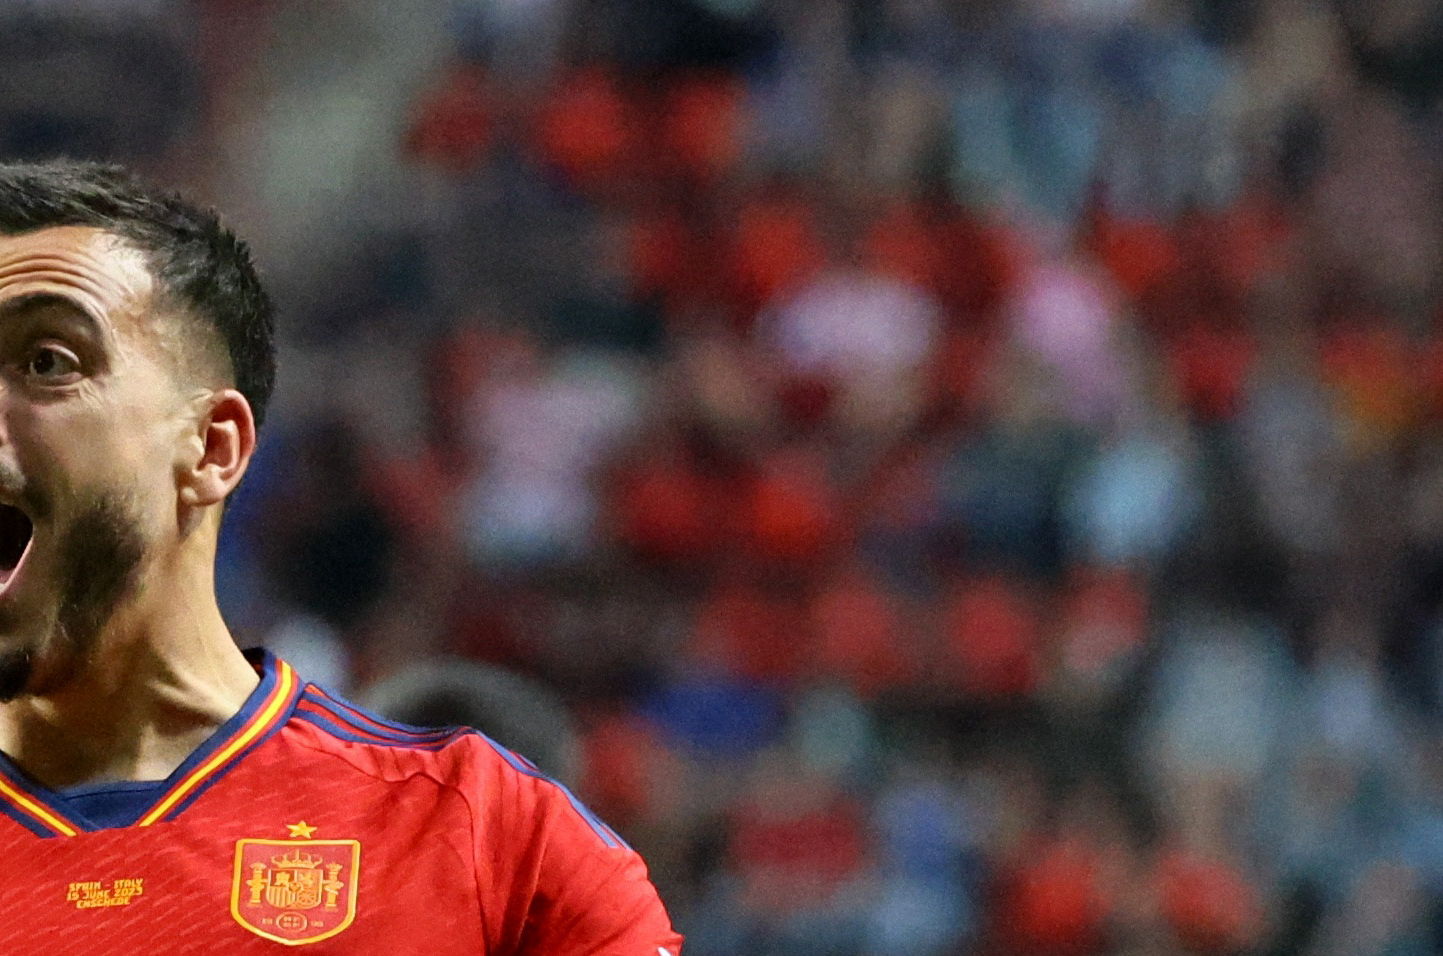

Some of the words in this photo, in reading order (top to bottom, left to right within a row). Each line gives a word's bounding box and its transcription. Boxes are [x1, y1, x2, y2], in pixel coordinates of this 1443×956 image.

[69, 881, 101, 892] SPAIN
[114, 878, 143, 890] ITALY
[82, 889, 110, 900] JUNE
[114, 887, 143, 897] 2023
[77, 897, 130, 908] ENSCHEDE
